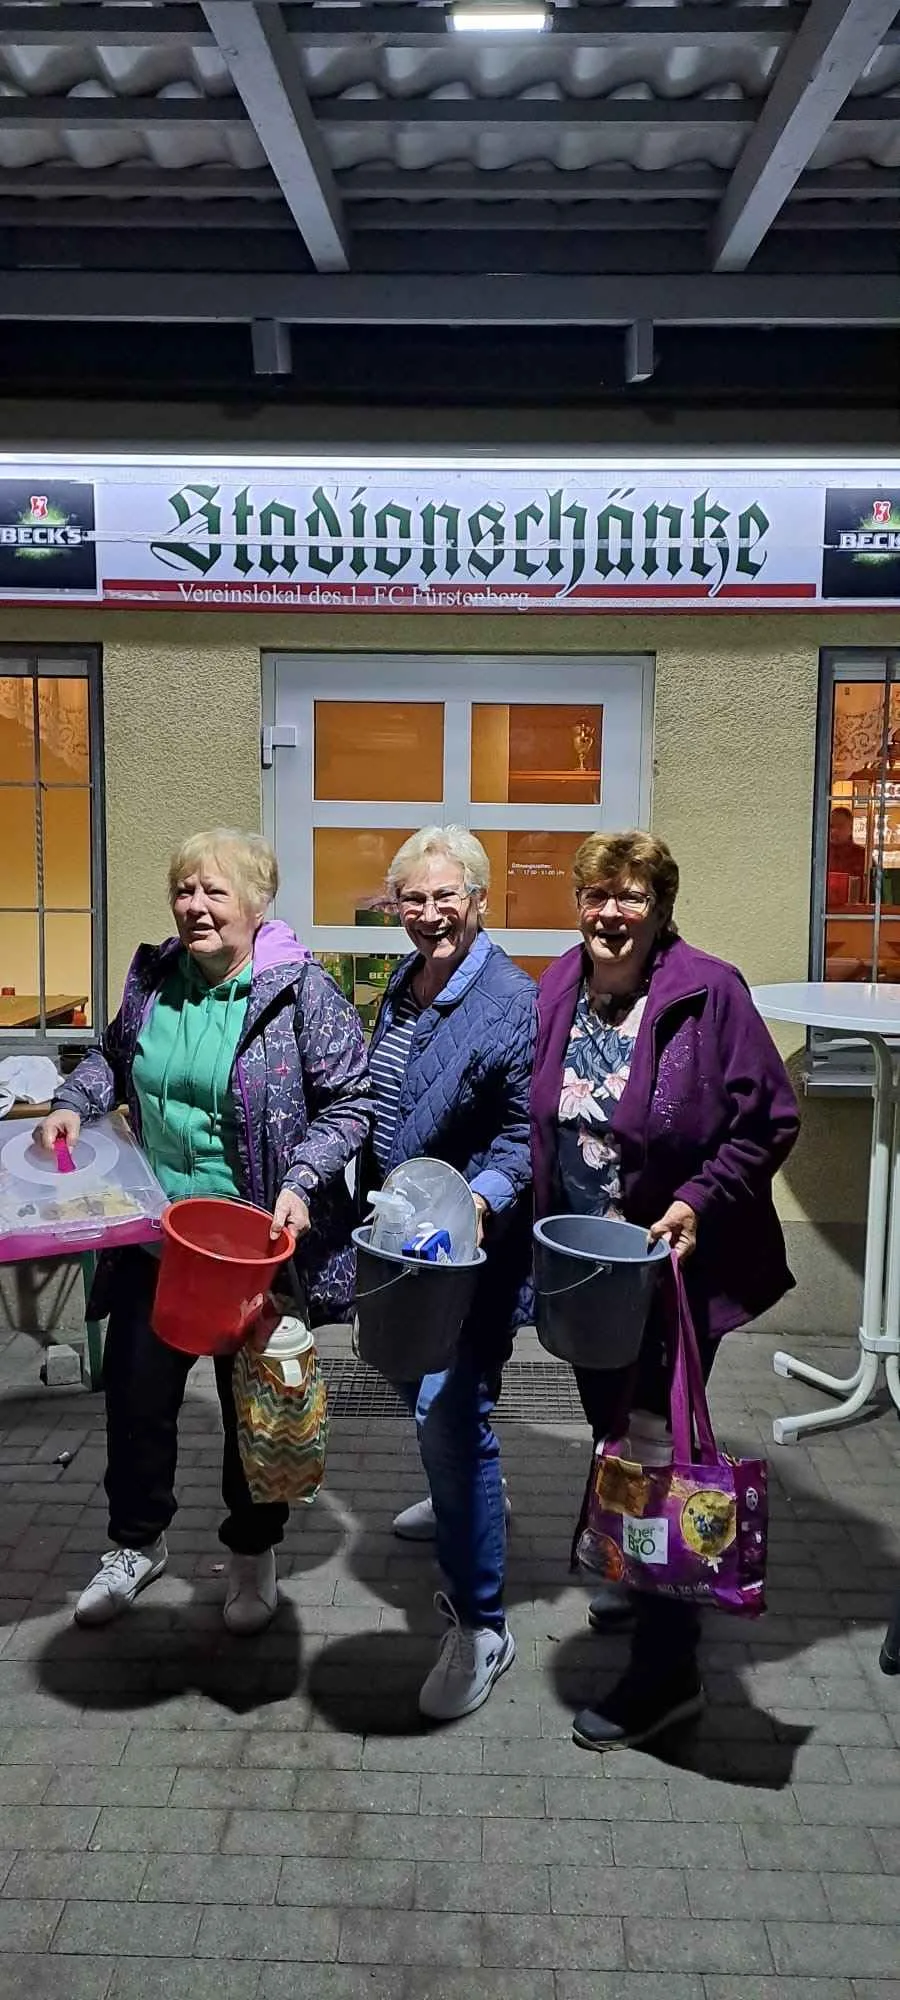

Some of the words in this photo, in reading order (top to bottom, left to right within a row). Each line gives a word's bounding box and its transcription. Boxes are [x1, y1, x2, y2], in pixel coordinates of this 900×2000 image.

[0, 526, 82, 545] BECK'S
[150, 484, 770, 598] Stadionschänke
[178, 583, 302, 604] Vereinslokal
[309, 585, 342, 605] des
[373, 585, 404, 606] FC
